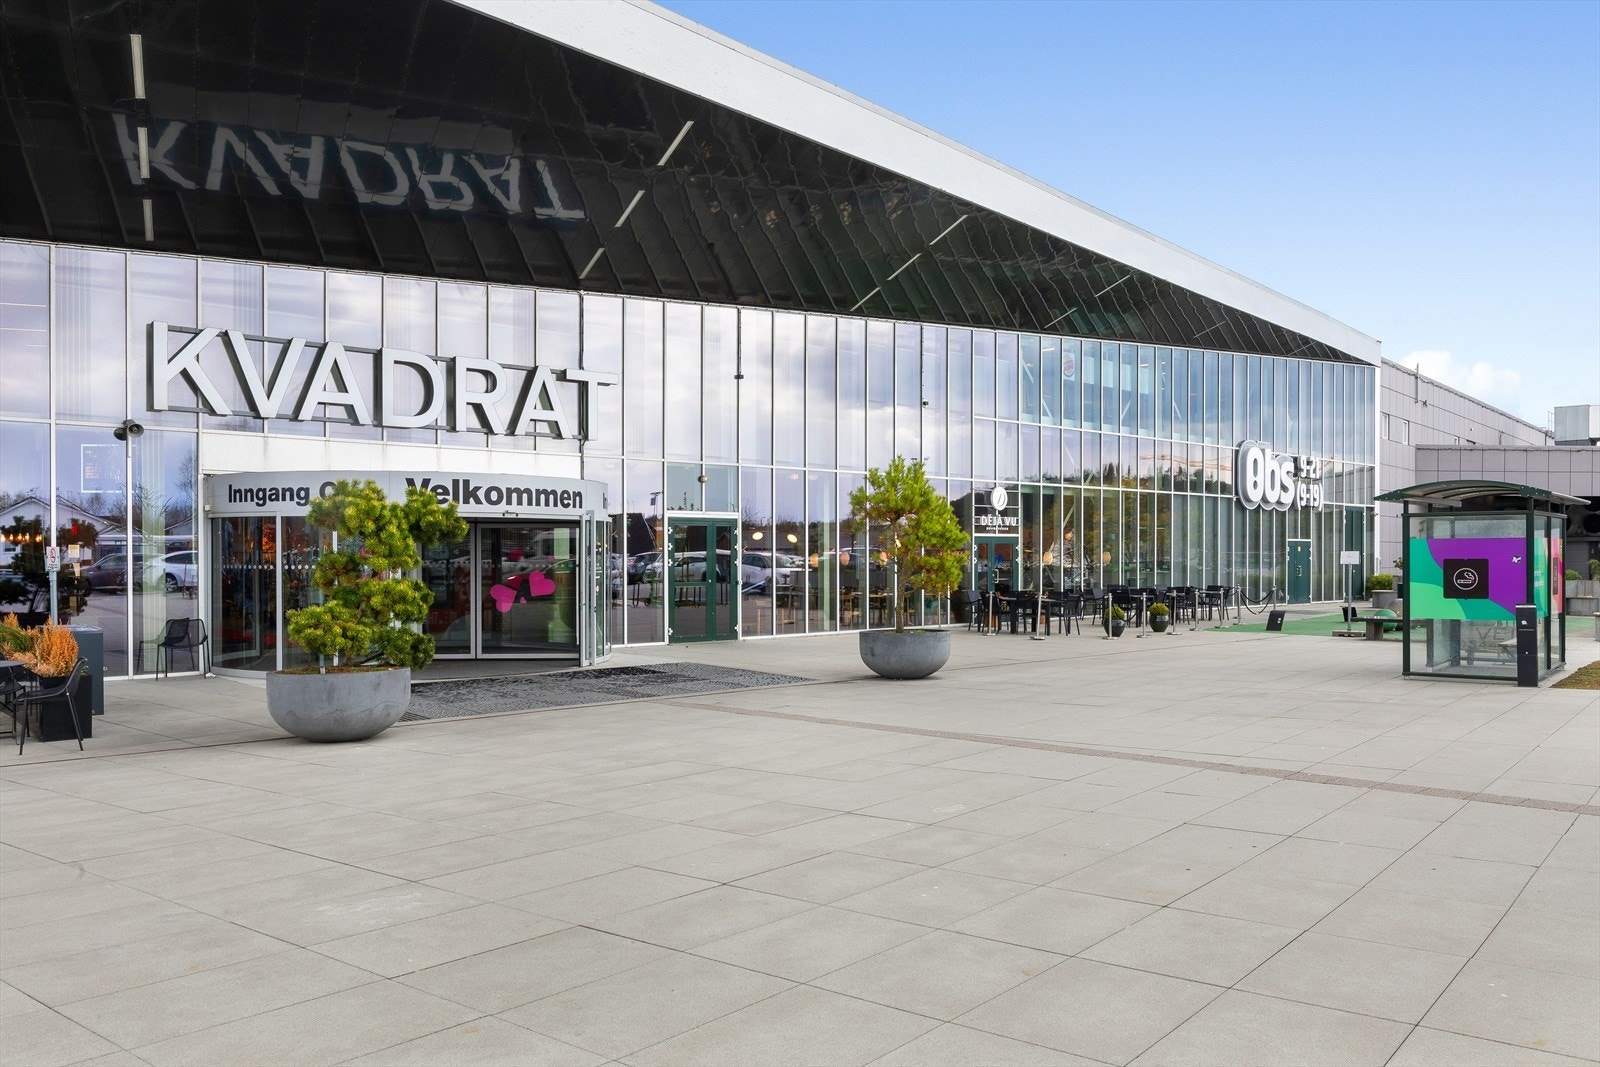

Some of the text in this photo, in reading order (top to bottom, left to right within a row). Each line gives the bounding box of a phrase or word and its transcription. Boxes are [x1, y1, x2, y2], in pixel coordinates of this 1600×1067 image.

[148, 321, 619, 441] KVADRAT
[1244, 446, 1296, 505] Obs
[1299, 455, 1320, 479] 9-21
[228, 484, 310, 507] Inngang
[405, 477, 583, 509] Velkommen
[1004, 516, 1017, 526] VU
